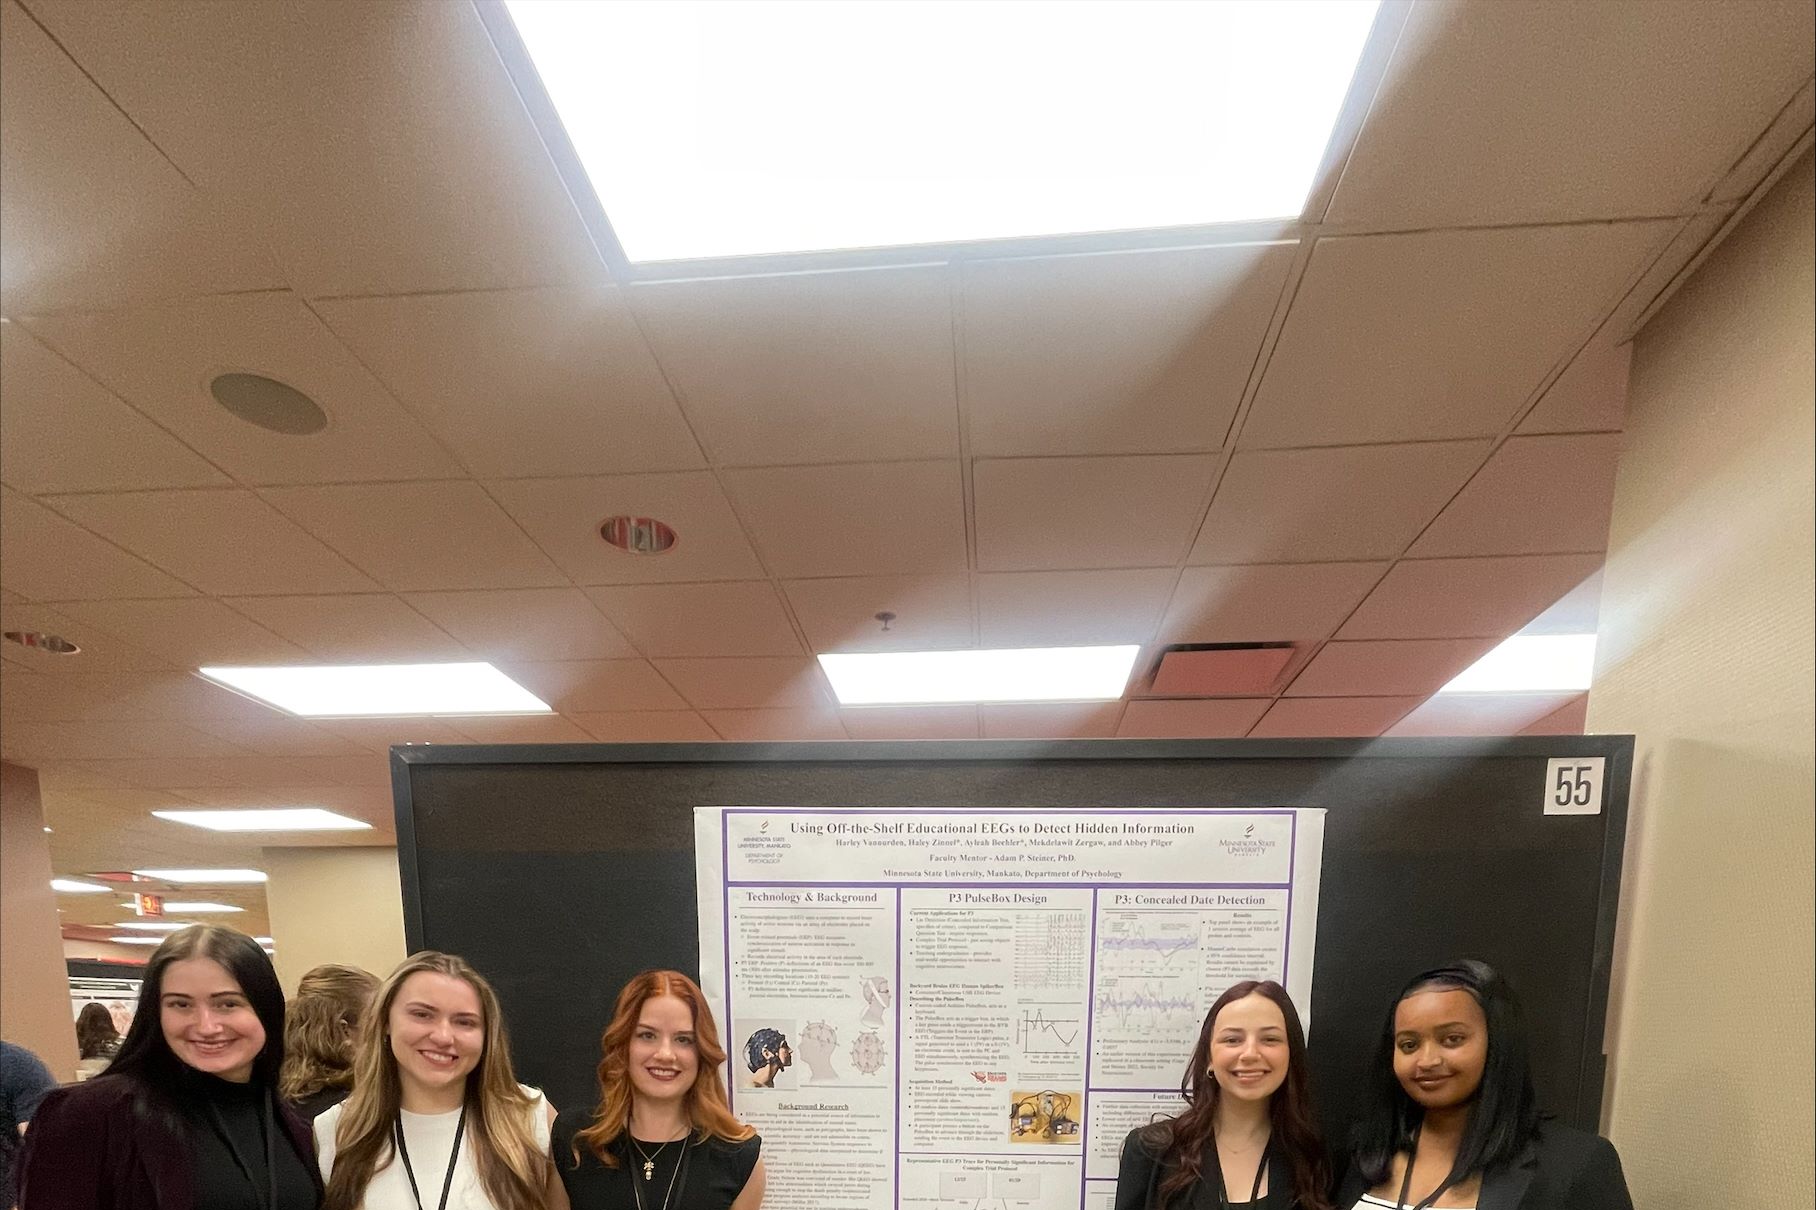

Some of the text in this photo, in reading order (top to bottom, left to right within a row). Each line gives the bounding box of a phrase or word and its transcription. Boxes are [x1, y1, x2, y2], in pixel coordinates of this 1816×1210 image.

[1555, 766, 1592, 806] 55
[791, 823, 1194, 835] Using Off-the-Shelf Educational EEGs to Detect Hidden Information
[1081, 870, 1122, 879] Psychology
[746, 892, 877, 904] Technology & Background
[949, 893, 1047, 904] P3 PulseBox Design
[1115, 895, 1265, 905] P3: Concealed Date Detection
[778, 1103, 819, 1111] Background
